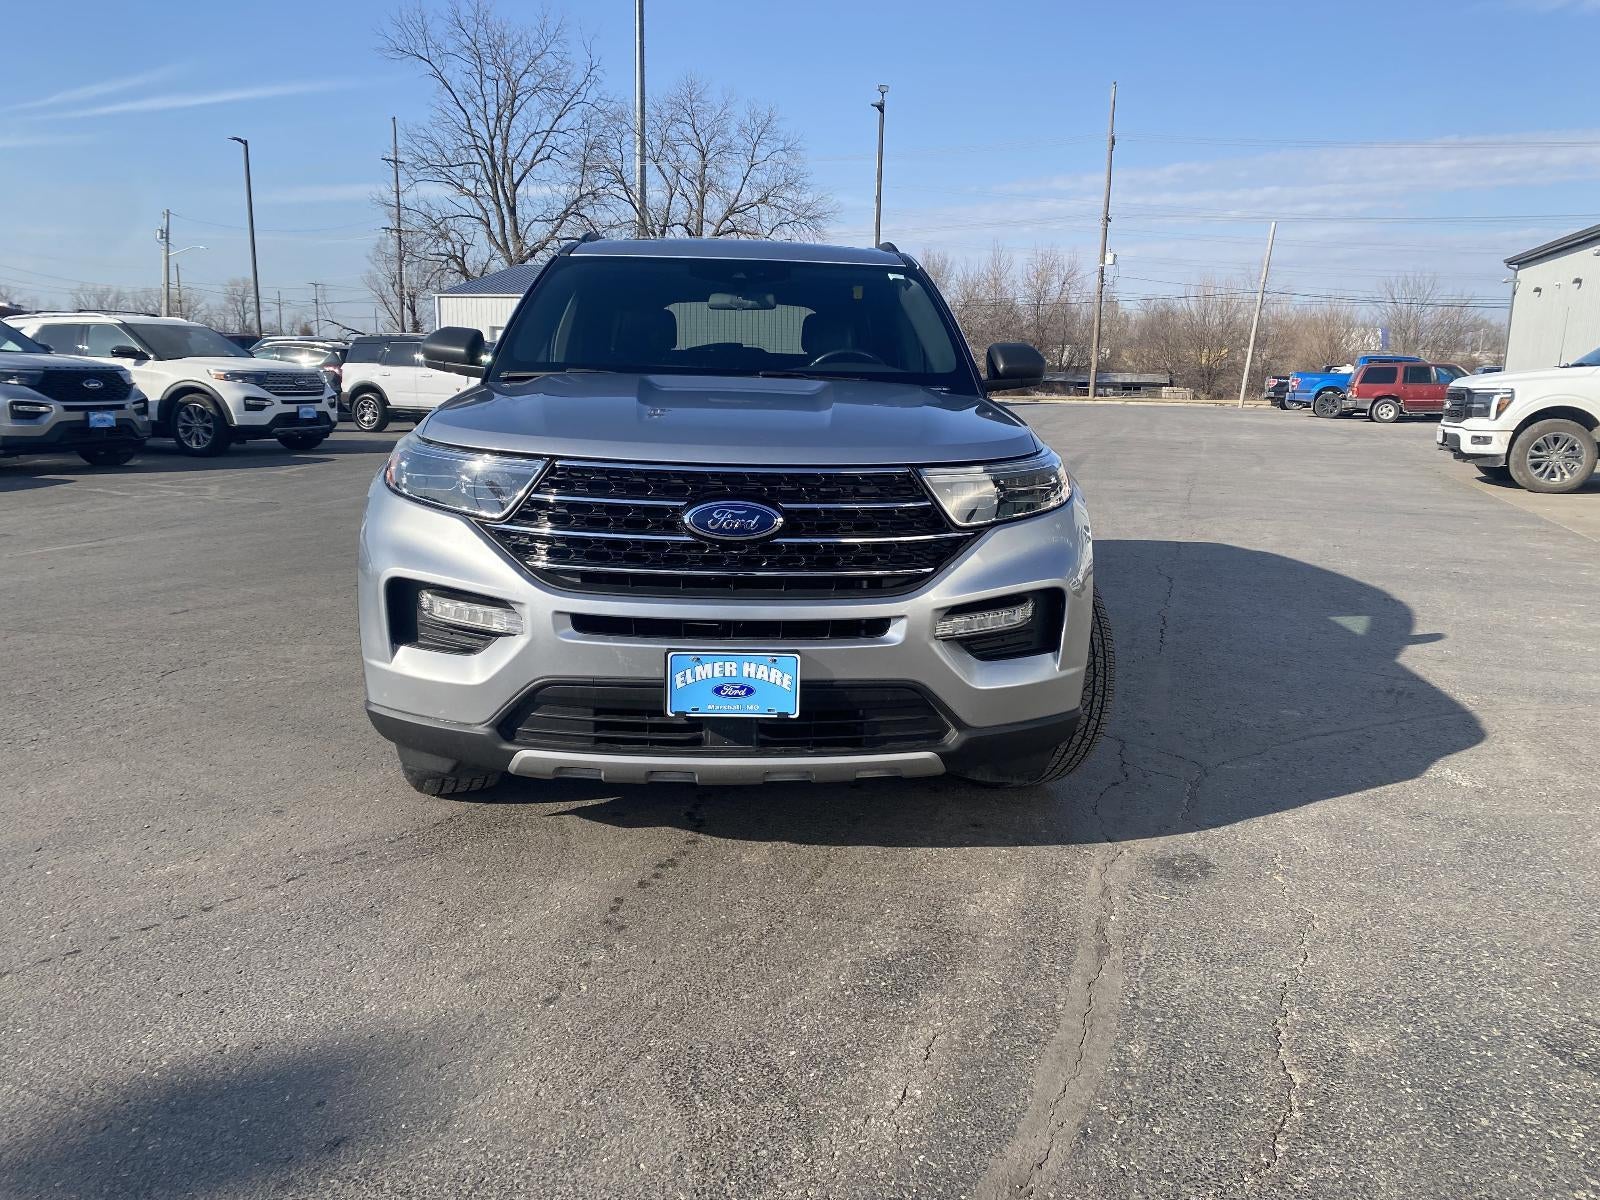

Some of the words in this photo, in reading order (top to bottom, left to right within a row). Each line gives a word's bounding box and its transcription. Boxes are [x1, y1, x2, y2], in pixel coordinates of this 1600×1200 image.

[708, 509, 760, 530] Ford
[675, 661, 737, 690] ELMER
[742, 661, 793, 691] HARE
[720, 684, 746, 696] Ford
